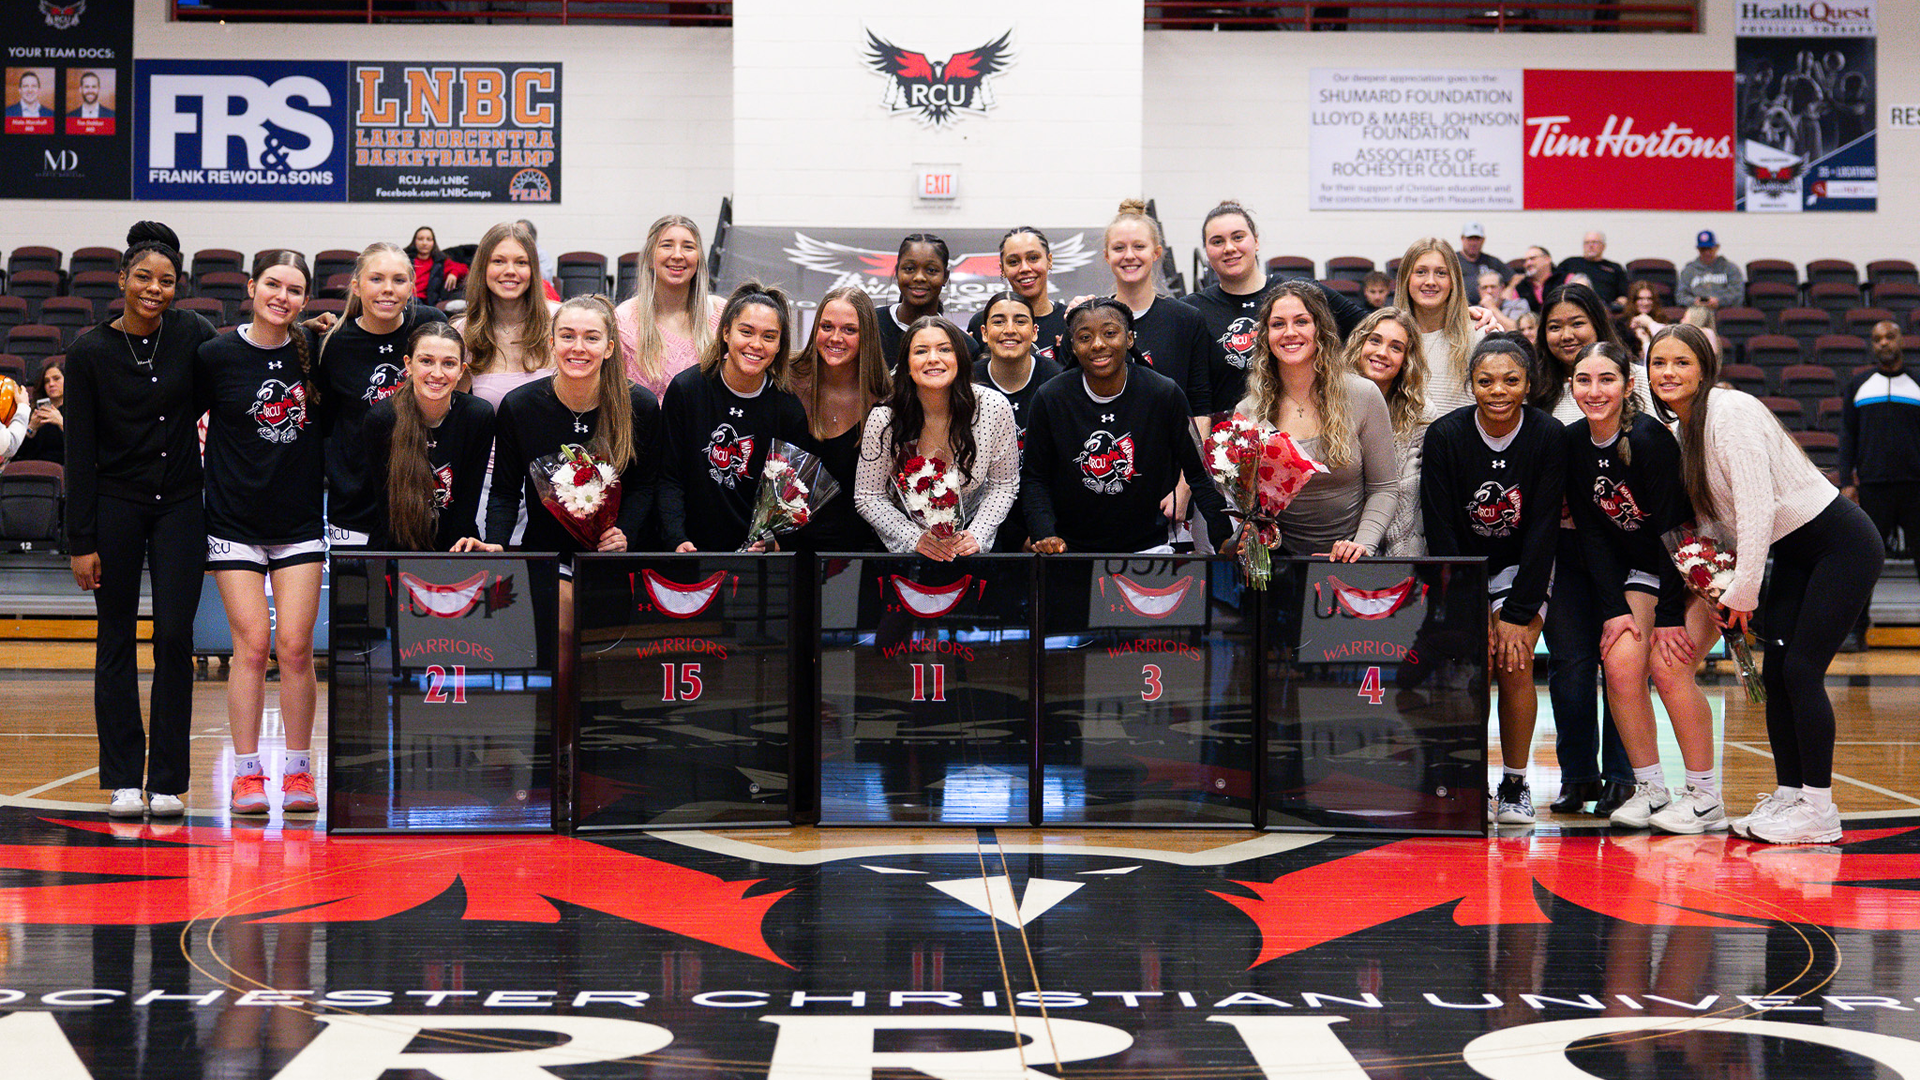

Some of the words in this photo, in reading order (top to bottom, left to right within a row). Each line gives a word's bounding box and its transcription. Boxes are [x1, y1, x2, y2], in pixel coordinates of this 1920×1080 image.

[1741, 1, 1870, 26] HealthQuest
[8, 46, 42, 58] YOUR
[44, 47, 76, 58] TEAM
[78, 48, 115, 59] DOCS:
[356, 66, 555, 128] LNBC
[911, 83, 966, 106] RCU
[1319, 89, 1402, 104] SHUMARD
[1406, 89, 1513, 104] FOUNDATION
[149, 74, 334, 170] FRS
[1312, 111, 1364, 126] LLOYD
[1369, 111, 1380, 126] &
[1384, 112, 1435, 126] MABEL
[1442, 112, 1520, 127] JOHNSON
[356, 129, 414, 148] LAKE
[419, 129, 555, 149] NORCENTRA
[1363, 126, 1470, 140] FOUNDATION
[1526, 115, 1591, 158] Tim
[1595, 113, 1731, 159] Hortons
[44, 149, 79, 171] MD
[356, 149, 492, 166] BASKETBALL
[496, 150, 554, 168] CAMP
[1355, 149, 1450, 163] ASSOCIATES
[1455, 149, 1476, 163] OF
[149, 170, 204, 184] FRANK
[398, 175, 470, 186] RCU.edu/LNBC
[1332, 163, 1425, 177] ROCHESTER
[1429, 163, 1500, 178] COLLEGE
[925, 174, 952, 194] EXIT
[509, 188, 551, 201] TEAM
[1233, 336, 1248, 345] RCU
[265, 405, 280, 418] RCU
[1089, 457, 1106, 469] RCU
[1480, 508, 1495, 518] RCU
[20, 541, 33, 550] 12
[208, 542, 231, 555] RCU
[399, 638, 494, 662] WARRIORS
[636, 637, 728, 660] WARRIORS
[882, 638, 975, 662] WARRIORS
[1107, 638, 1201, 661] WARRIORS
[1323, 640, 1420, 664] WARRIORS
[423, 664, 467, 703] 21
[661, 663, 703, 702] 15
[910, 663, 946, 702] 11
[1141, 663, 1163, 702] 3
[1357, 666, 1385, 705] 4
[0, 988, 650, 1008] CHESTER
[692, 990, 1383, 1009] CHRISTIAN
[1422, 993, 1920, 1012] UNIVER
